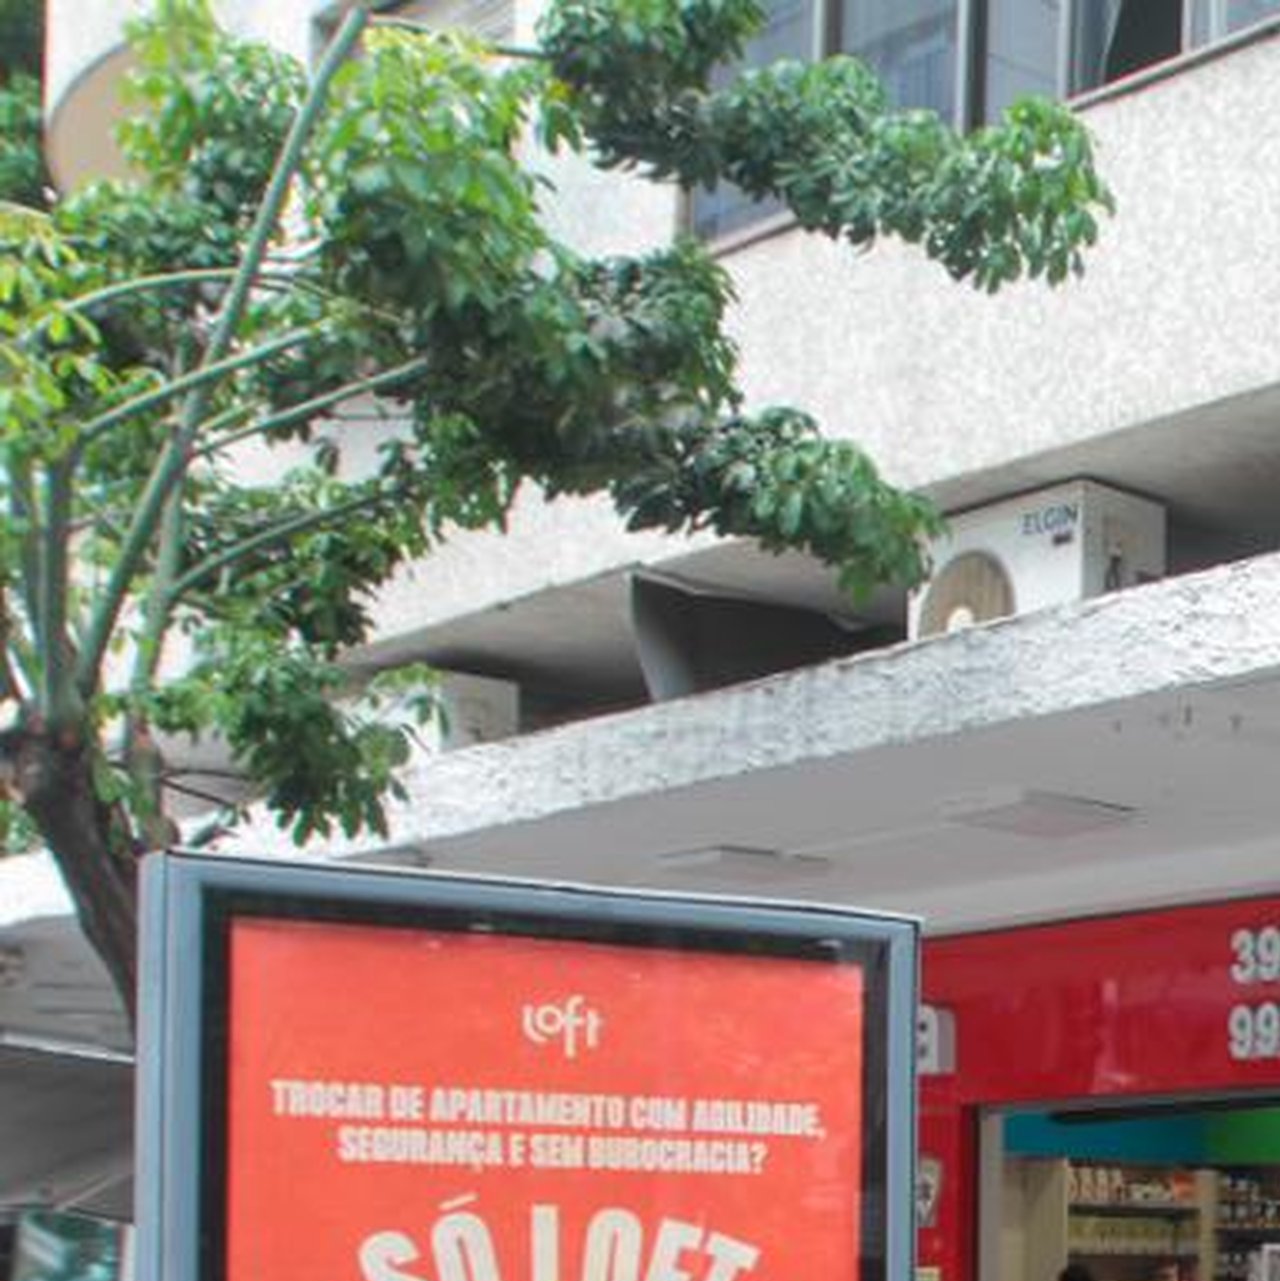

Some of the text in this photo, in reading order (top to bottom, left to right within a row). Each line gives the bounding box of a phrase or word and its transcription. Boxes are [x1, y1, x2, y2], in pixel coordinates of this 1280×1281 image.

[1020, 504, 1079, 535] ELGIN
[270, 1079, 384, 1119] TROCAR
[389, 1085, 424, 1120] DE
[429, 1087, 625, 1129] APARTAMENTO
[630, 1095, 687, 1131] COM
[337, 1126, 768, 1174] SEGURANÇA E SEM BUROCRACIA?
